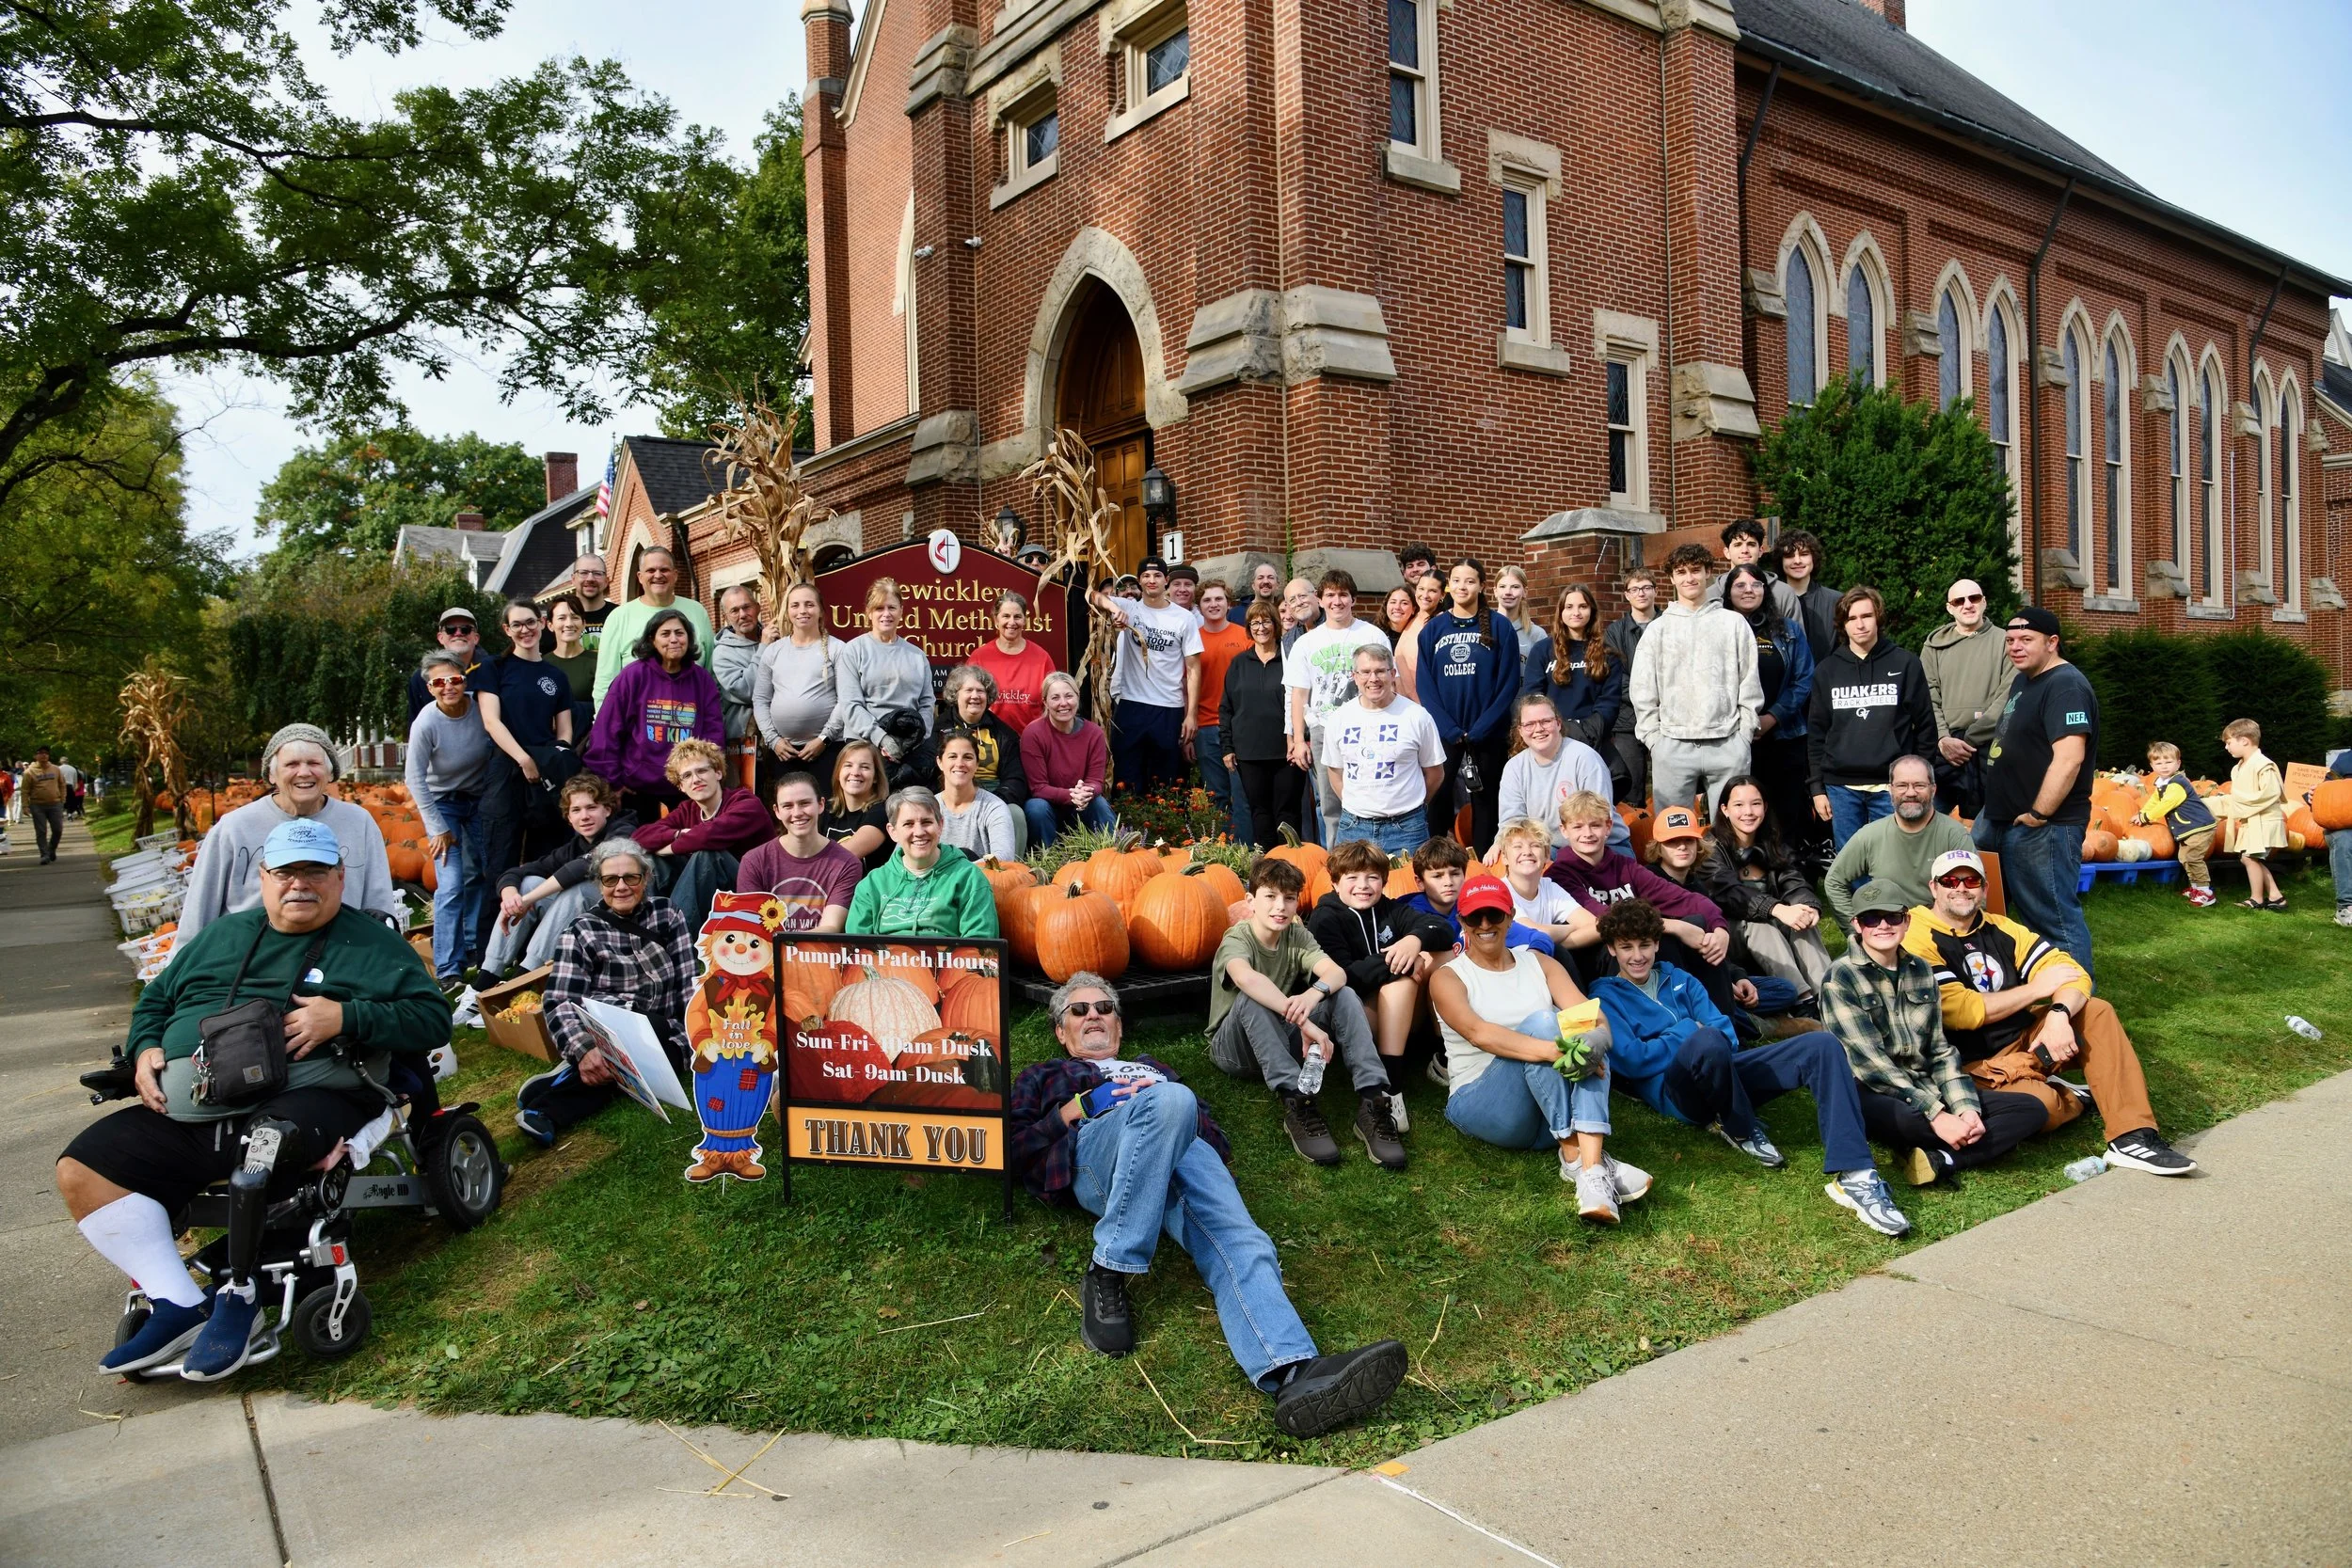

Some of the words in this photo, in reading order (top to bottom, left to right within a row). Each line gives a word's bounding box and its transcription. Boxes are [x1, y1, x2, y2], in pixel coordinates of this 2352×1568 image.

[1169, 537, 1177, 560] 1
[899, 578, 1009, 602] ewickley
[830, 605, 922, 629] Und
[928, 607, 1053, 633] Methist
[1145, 626, 1176, 638] WELCOME
[1146, 643, 1166, 652] SHED
[1147, 636, 1174, 647] TOOLE
[1435, 632, 1490, 655] WESTMINST
[1311, 643, 1360, 667] GREE
[1443, 662, 1477, 676] COLLEGE
[998, 689, 1031, 703] ickley
[1831, 683, 1899, 700] QUAKERS
[1833, 699, 1861, 707] TRACK
[1870, 696, 1897, 705] FIELD
[647, 724, 663, 743] BE
[667, 727, 693, 742] KIN
[1947, 850, 1971, 861] USA
[1583, 883, 1635, 905] PEN
[800, 918, 819, 929] VAL
[786, 945, 874, 970] Pumpkin
[878, 949, 933, 968] Patch
[937, 951, 999, 971] Hours
[723, 1019, 752, 1031] Fall
[729, 1030, 744, 1039] in
[722, 1038, 752, 1050] love
[822, 1061, 860, 1079] Sat-
[865, 1063, 967, 1085] 9am-Dusk
[804, 1117, 913, 1159] THANK
[922, 1125, 987, 1164] YOU
[372, 1183, 395, 1199] Eagle
[397, 1183, 409, 1196] HD
